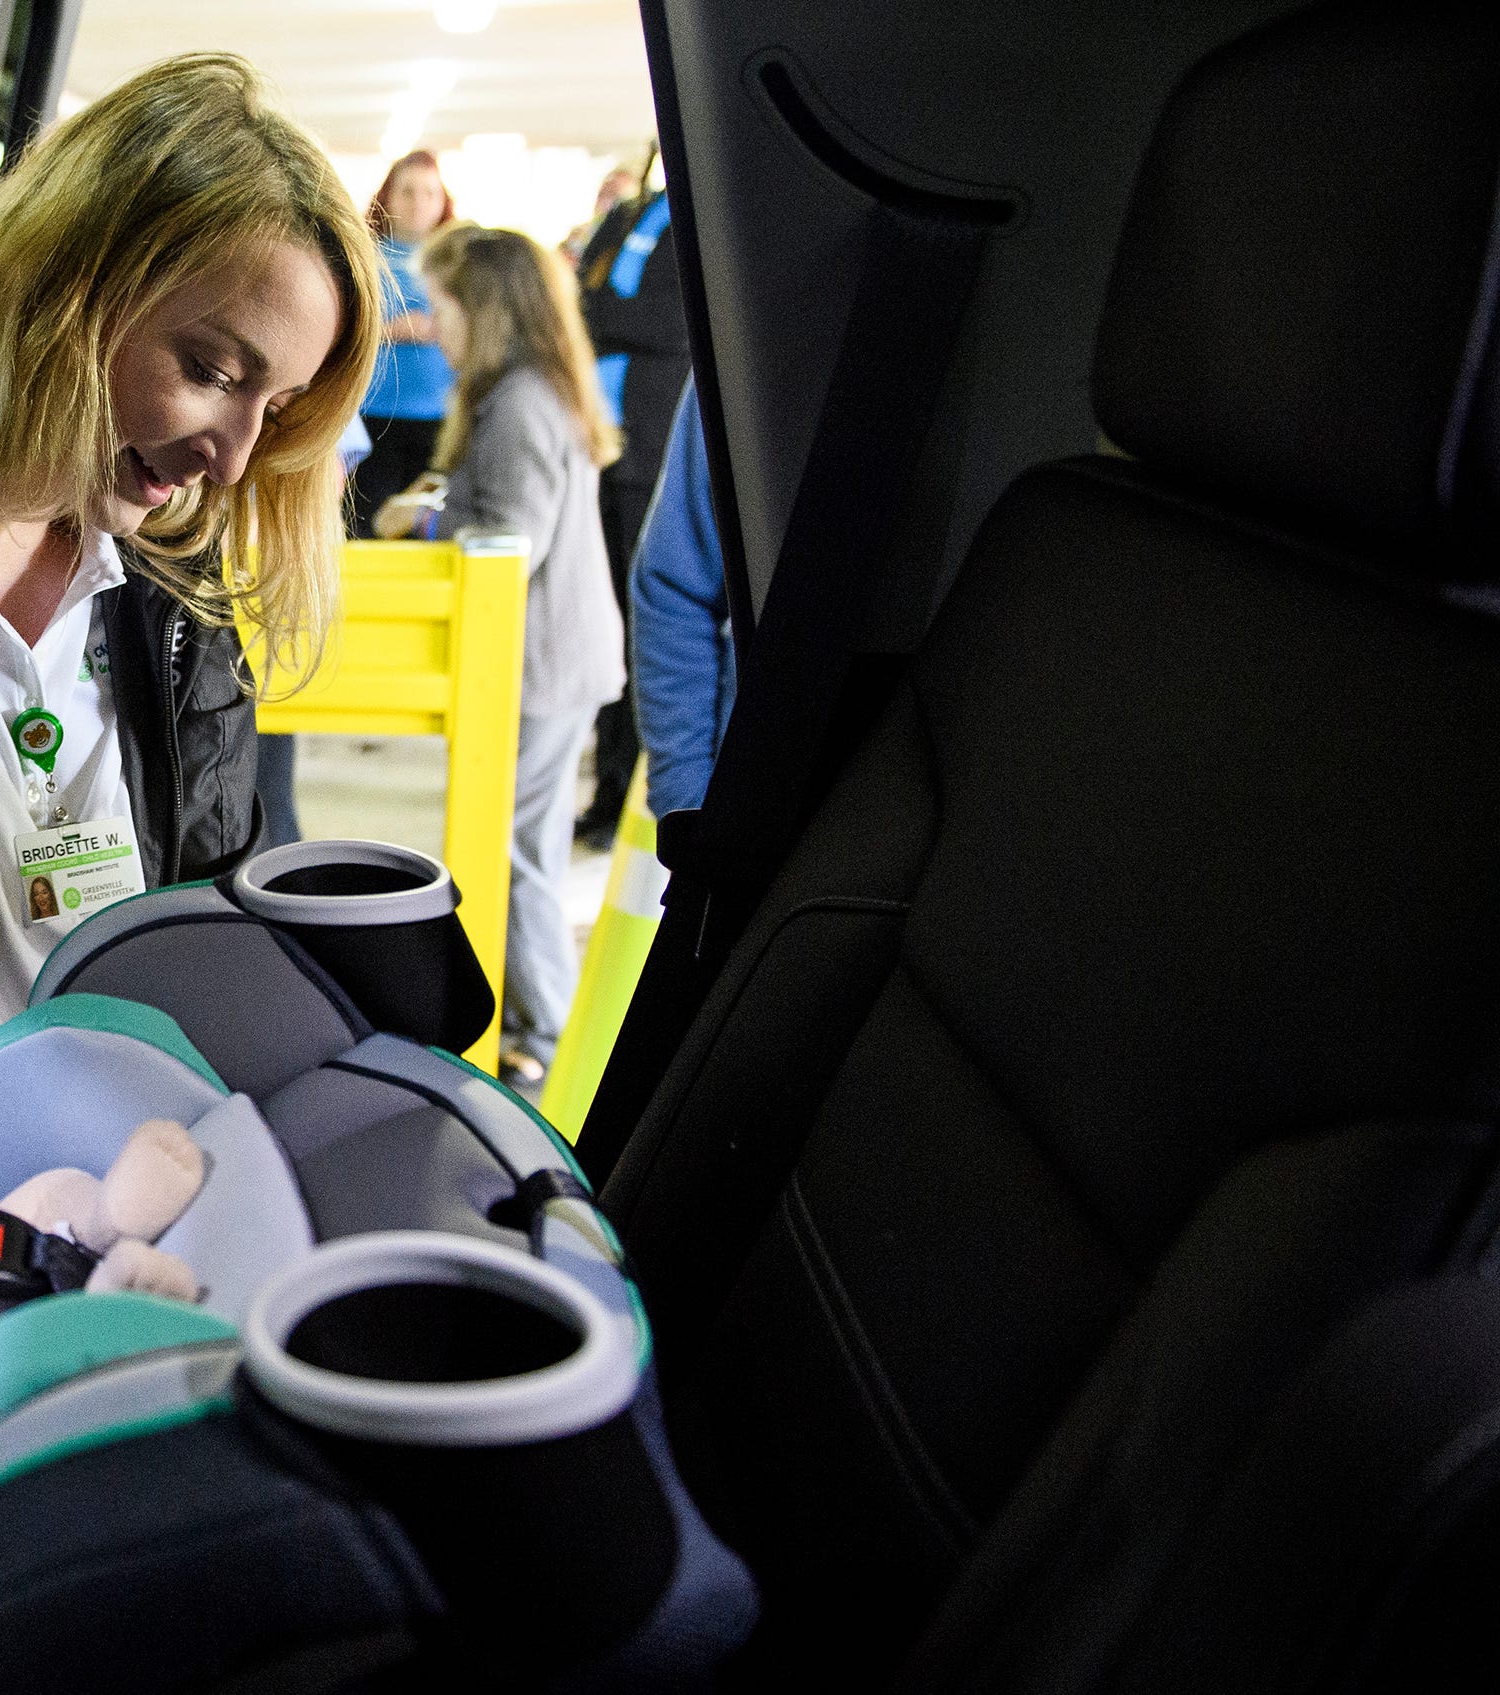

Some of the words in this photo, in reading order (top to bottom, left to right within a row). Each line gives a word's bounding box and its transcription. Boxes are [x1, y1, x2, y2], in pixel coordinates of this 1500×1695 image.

[22, 837, 100, 863] BRIDGETTE
[105, 833, 123, 846] W.
[82, 880, 123, 894] GREENVILLE
[84, 891, 111, 903] HEALTH
[111, 887, 135, 897] SYSTEM
